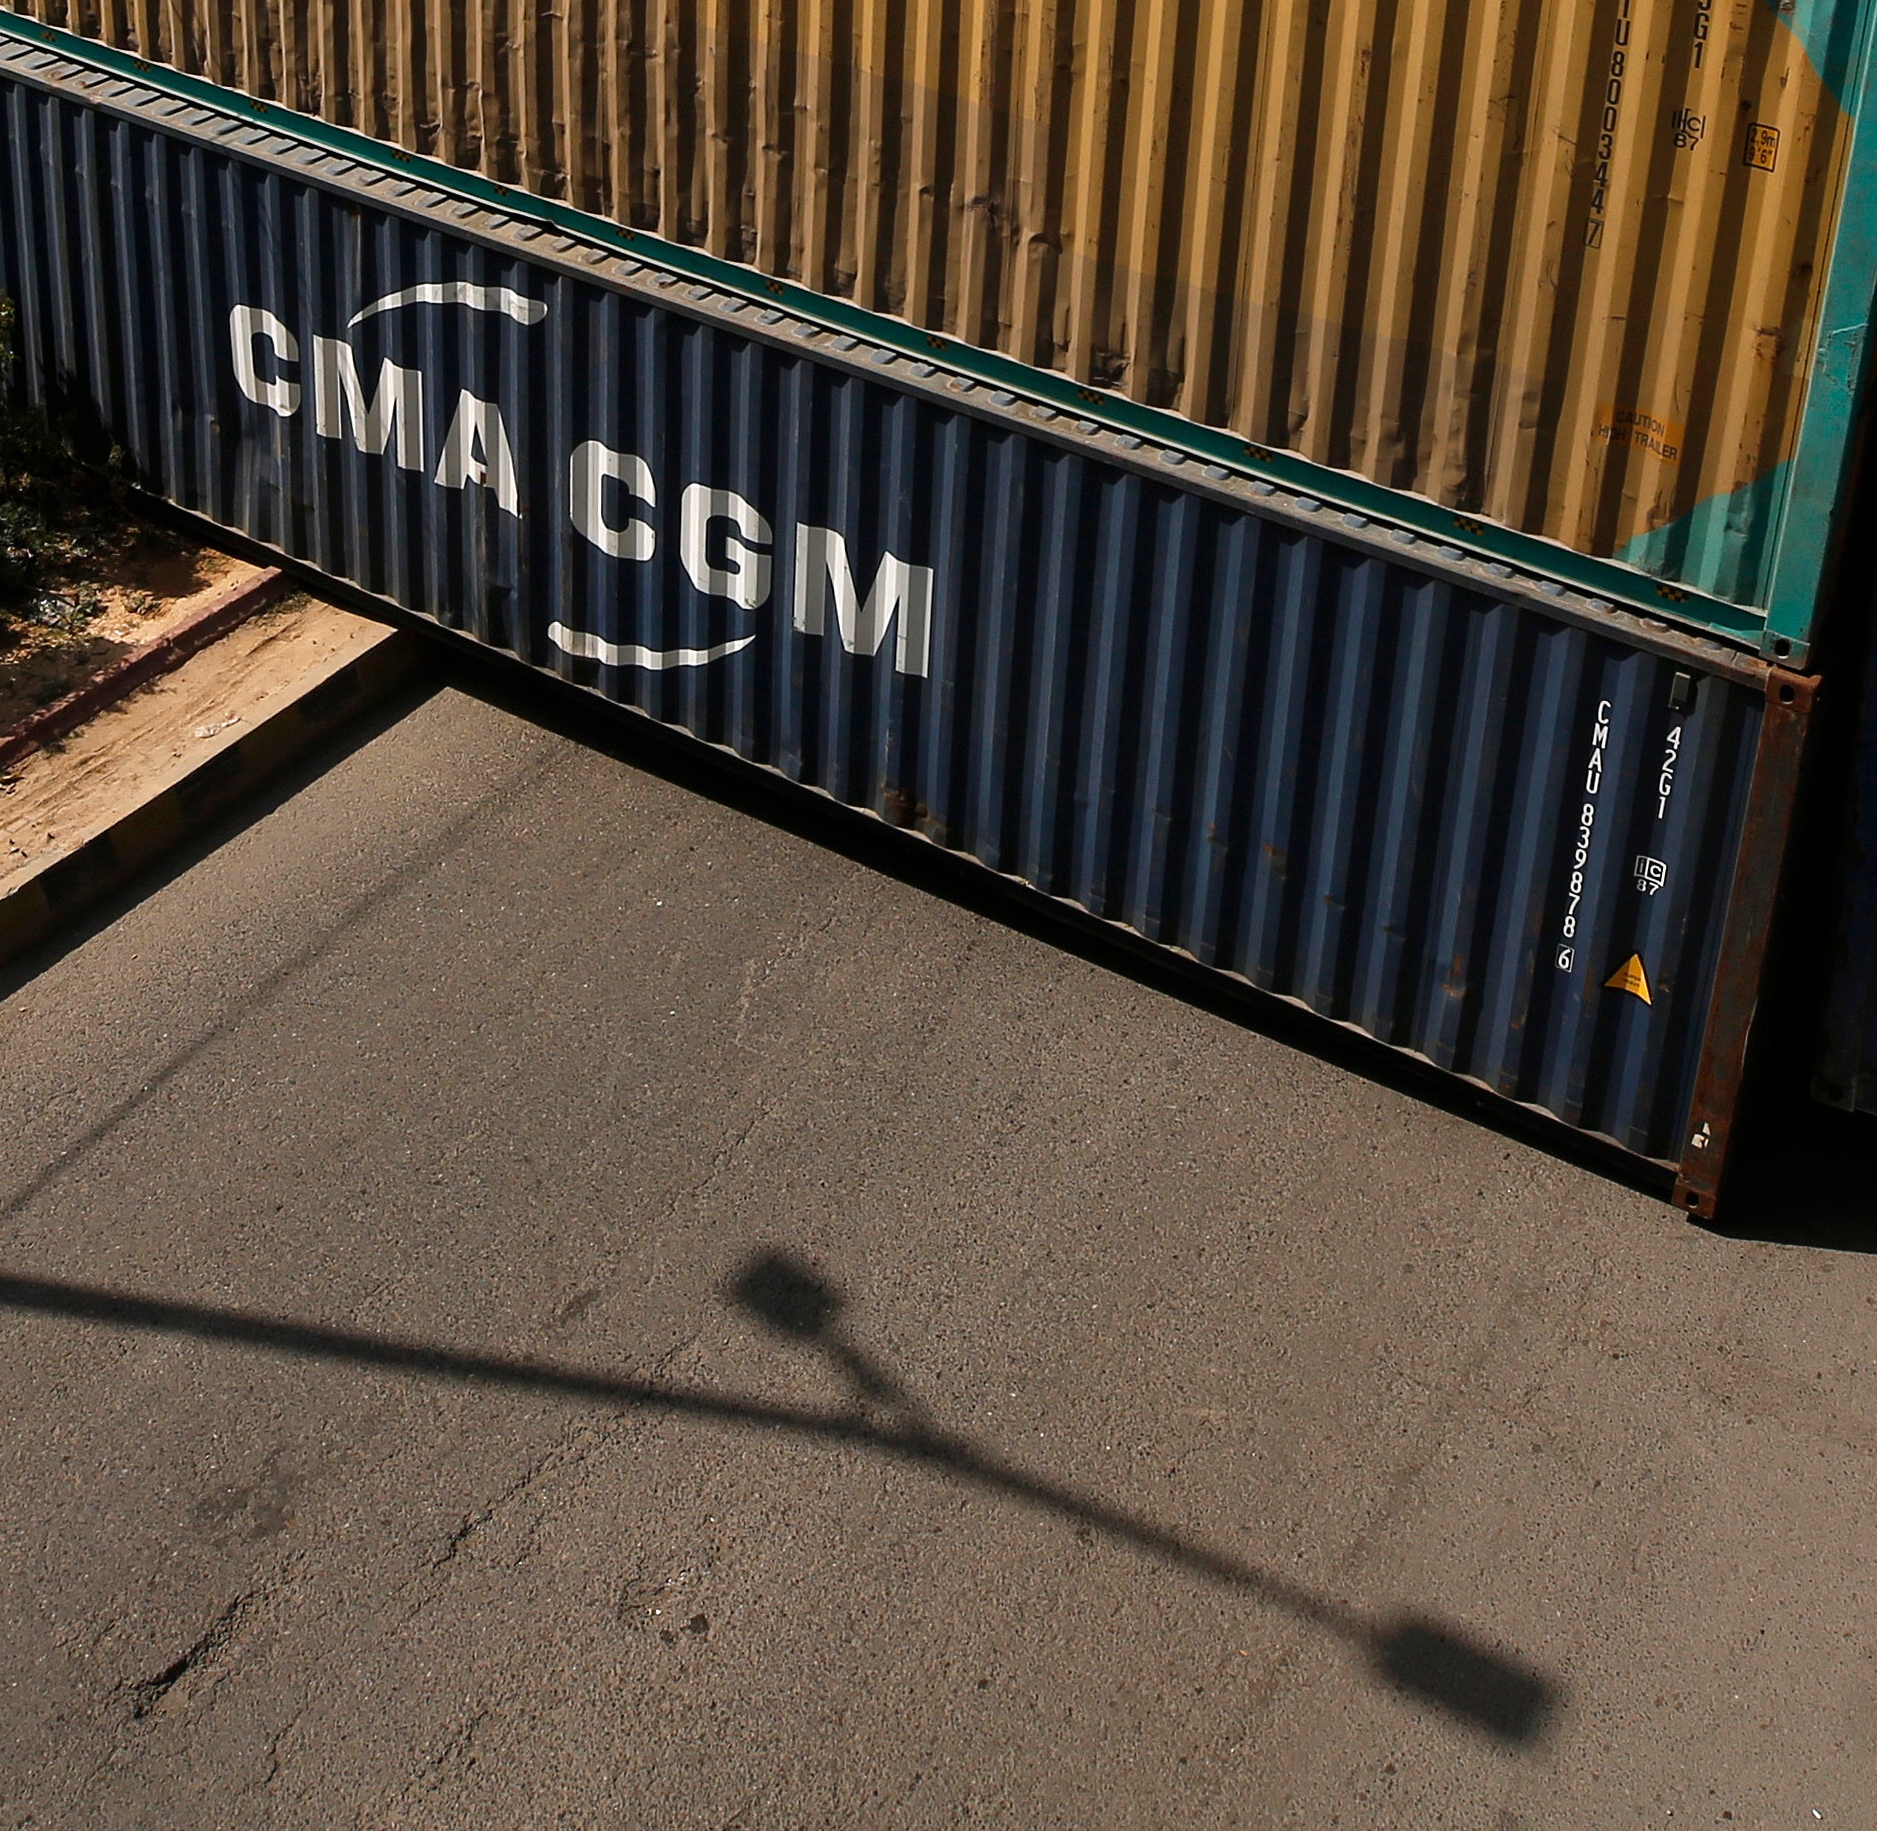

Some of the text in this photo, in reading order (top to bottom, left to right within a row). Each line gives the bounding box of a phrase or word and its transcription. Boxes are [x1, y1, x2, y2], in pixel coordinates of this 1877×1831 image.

[1673, 133, 1701, 152] 87
[1616, 410, 1666, 438] CAUTION
[229, 303, 936, 679] CMA CGM
[1585, 700, 1612, 795] CMAU
[1657, 725, 1683, 820] 42G1
[1562, 803, 1595, 939] 839878
[1635, 878, 1660, 896] 87
